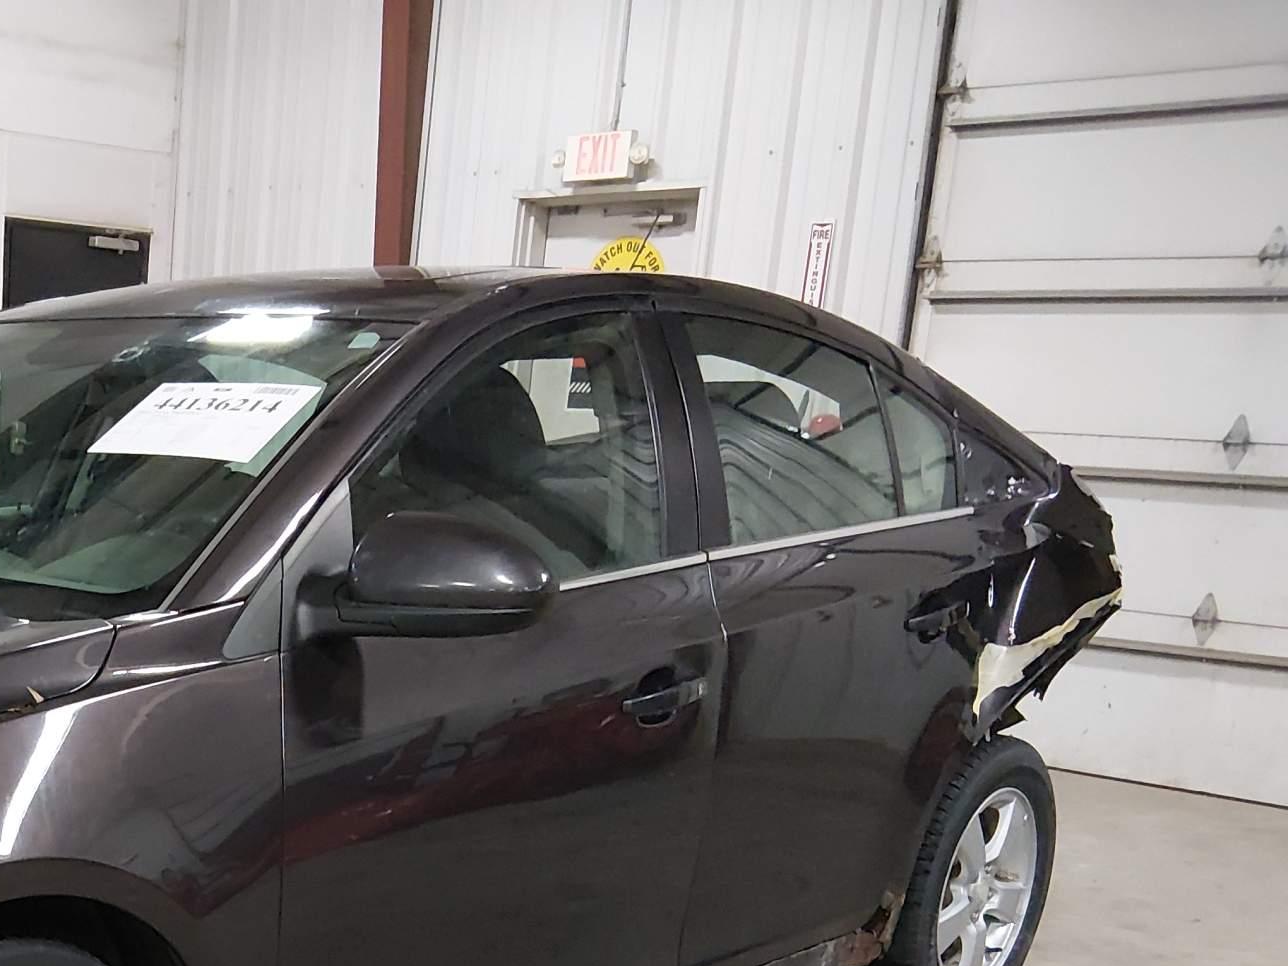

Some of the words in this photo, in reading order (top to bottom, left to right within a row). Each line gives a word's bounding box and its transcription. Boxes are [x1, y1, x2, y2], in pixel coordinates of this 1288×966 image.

[576, 133, 621, 175] EXIT
[812, 229, 830, 240] FIRE
[154, 397, 282, 413] 44136214
